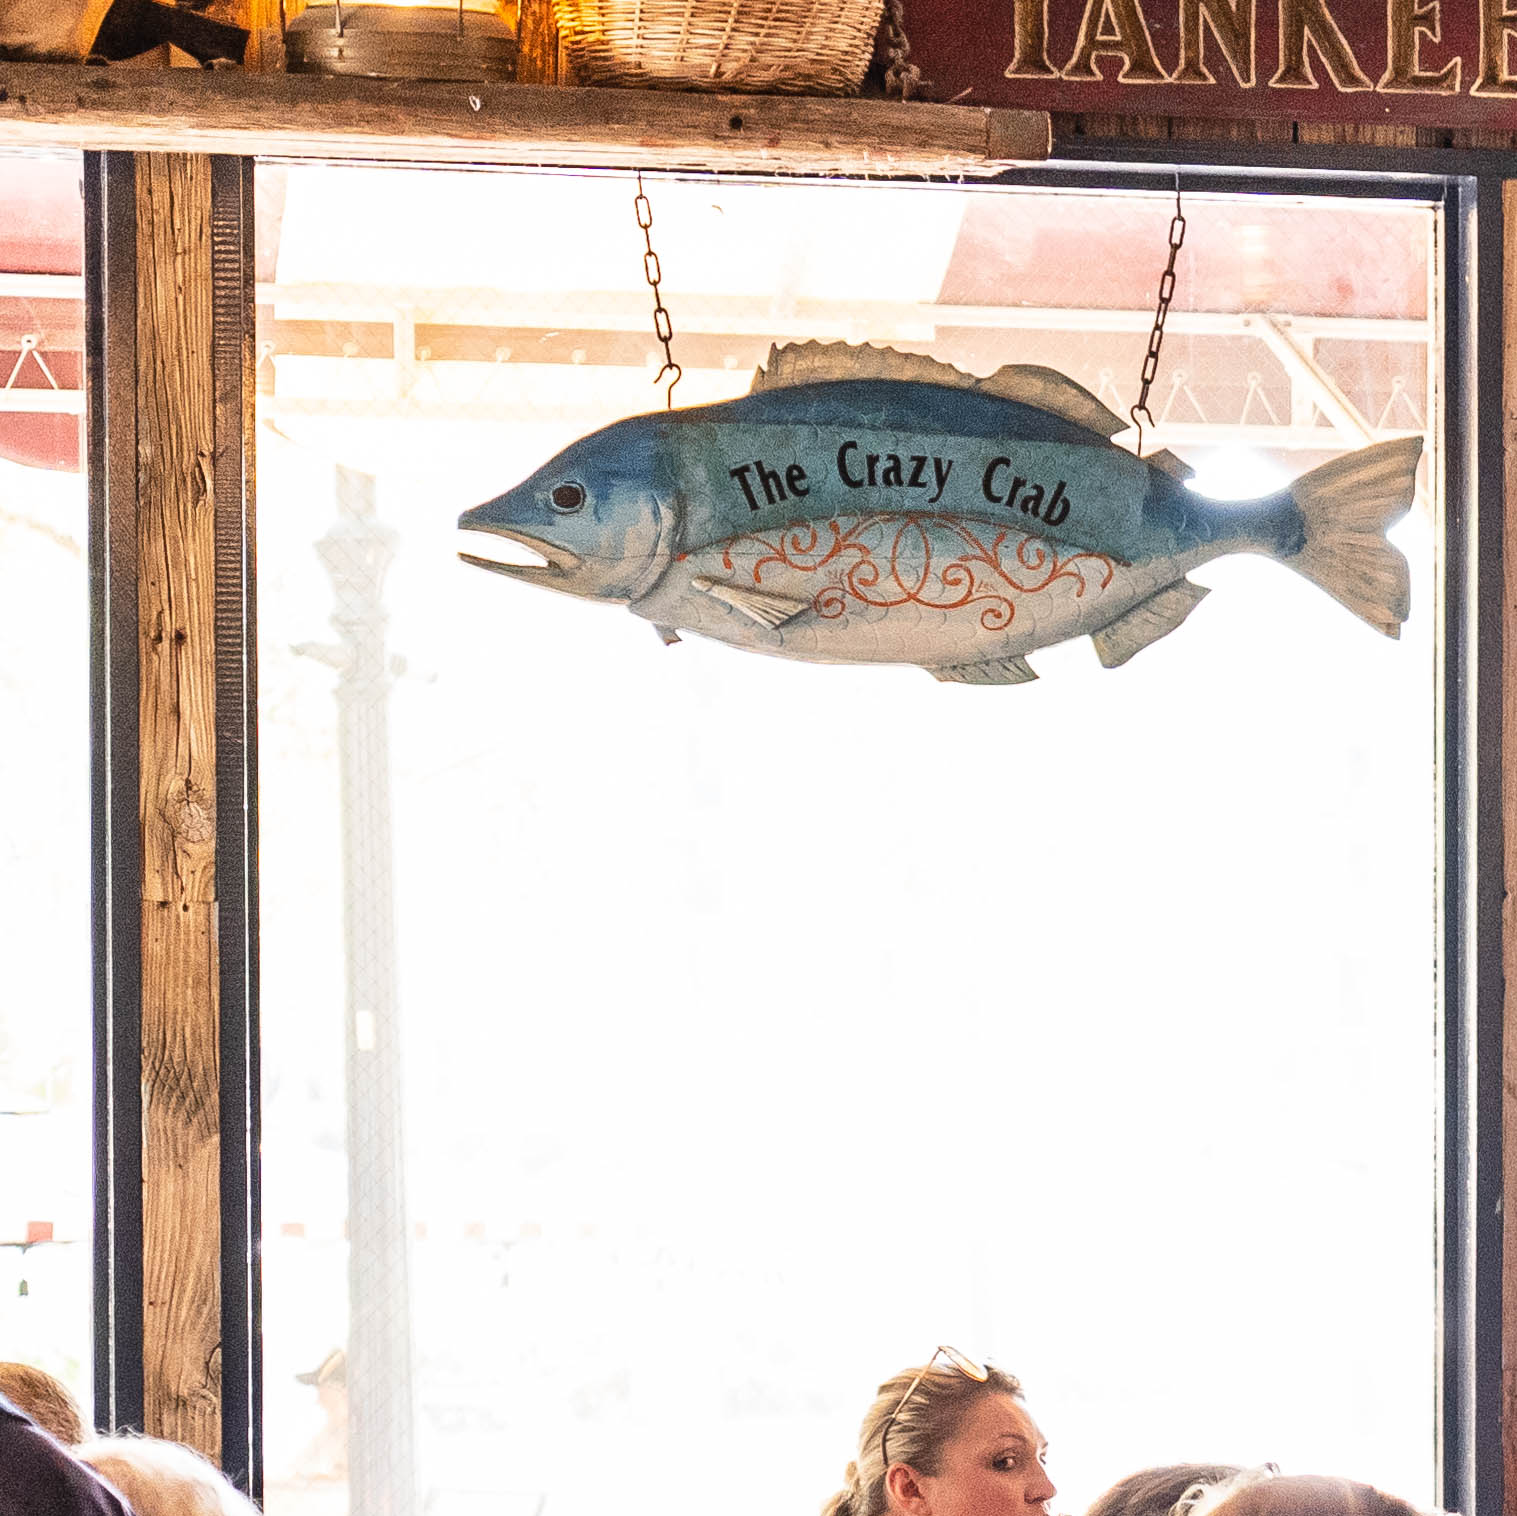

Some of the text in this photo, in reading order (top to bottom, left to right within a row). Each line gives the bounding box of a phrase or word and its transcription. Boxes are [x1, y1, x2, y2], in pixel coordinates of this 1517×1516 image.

[729, 440, 1072, 527] The Crazy Crab
